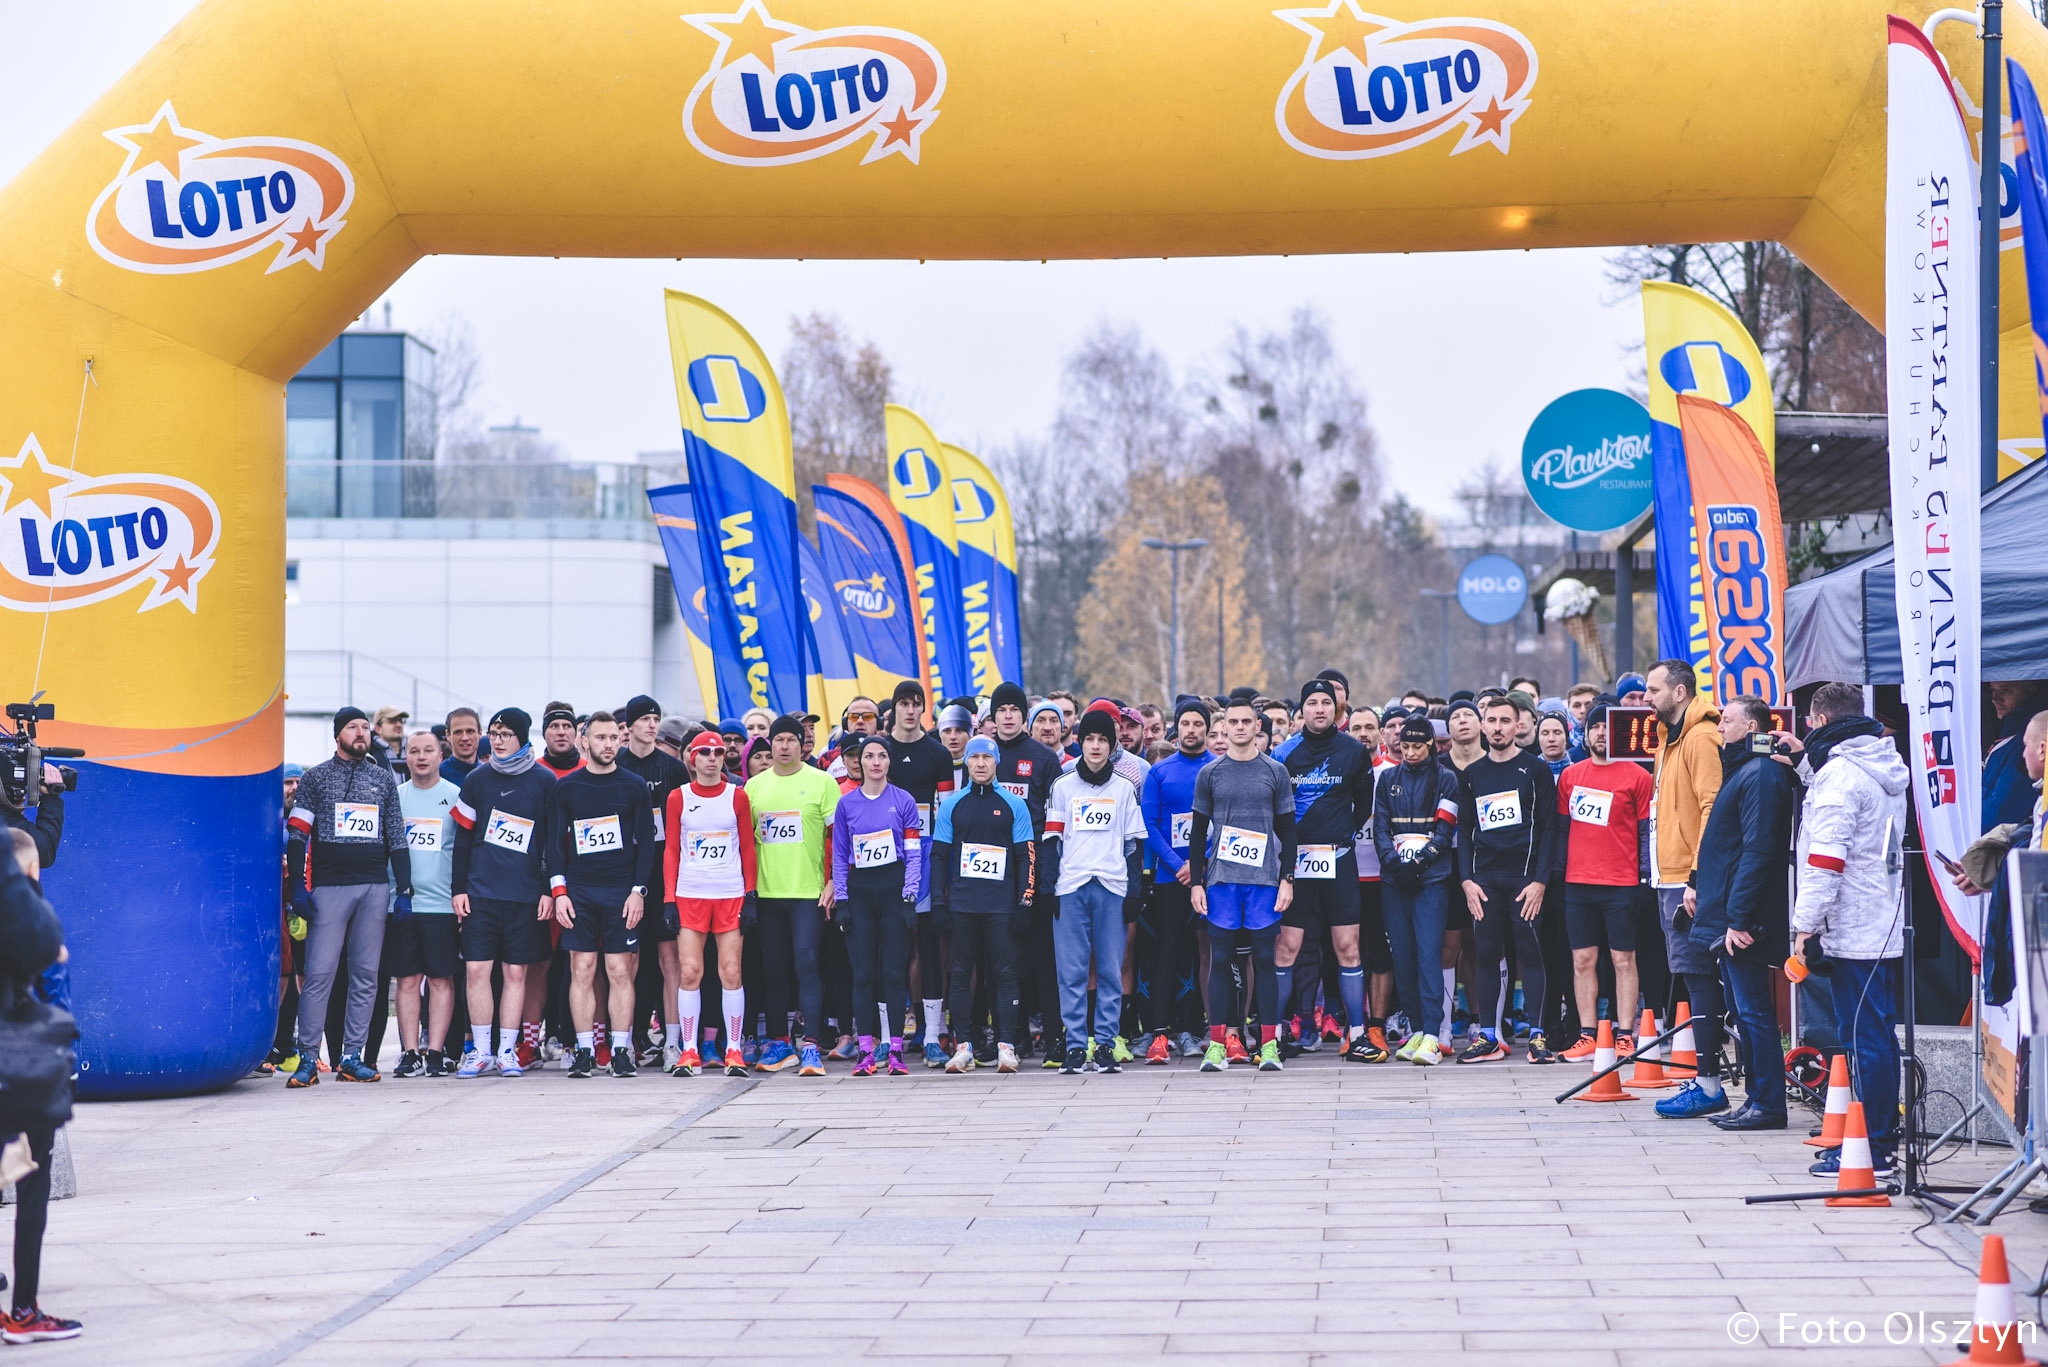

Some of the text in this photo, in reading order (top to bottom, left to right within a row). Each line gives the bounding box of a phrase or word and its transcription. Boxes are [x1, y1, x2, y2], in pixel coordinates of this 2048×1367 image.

[1333, 49, 1482, 126] LOTTO
[739, 58, 889, 133] LOTTO
[145, 170, 297, 239] LOTTO
[1600, 480, 1652, 489] RESTAURANT
[19, 506, 168, 577] LOTTO
[1463, 576, 1521, 594] MOLO
[1086, 812, 1111, 825] 699
[1489, 807, 1515, 821] 653
[1578, 804, 1602, 819] 671
[349, 818, 374, 832] 720
[771, 825, 796, 838] 765
[409, 832, 435, 845] 755
[498, 828, 523, 845] 754
[589, 832, 616, 847] 512
[700, 846, 727, 859] 737
[864, 846, 889, 861] 767
[1231, 844, 1259, 860] 503
[972, 859, 999, 873] 521
[1303, 860, 1329, 873] 700
